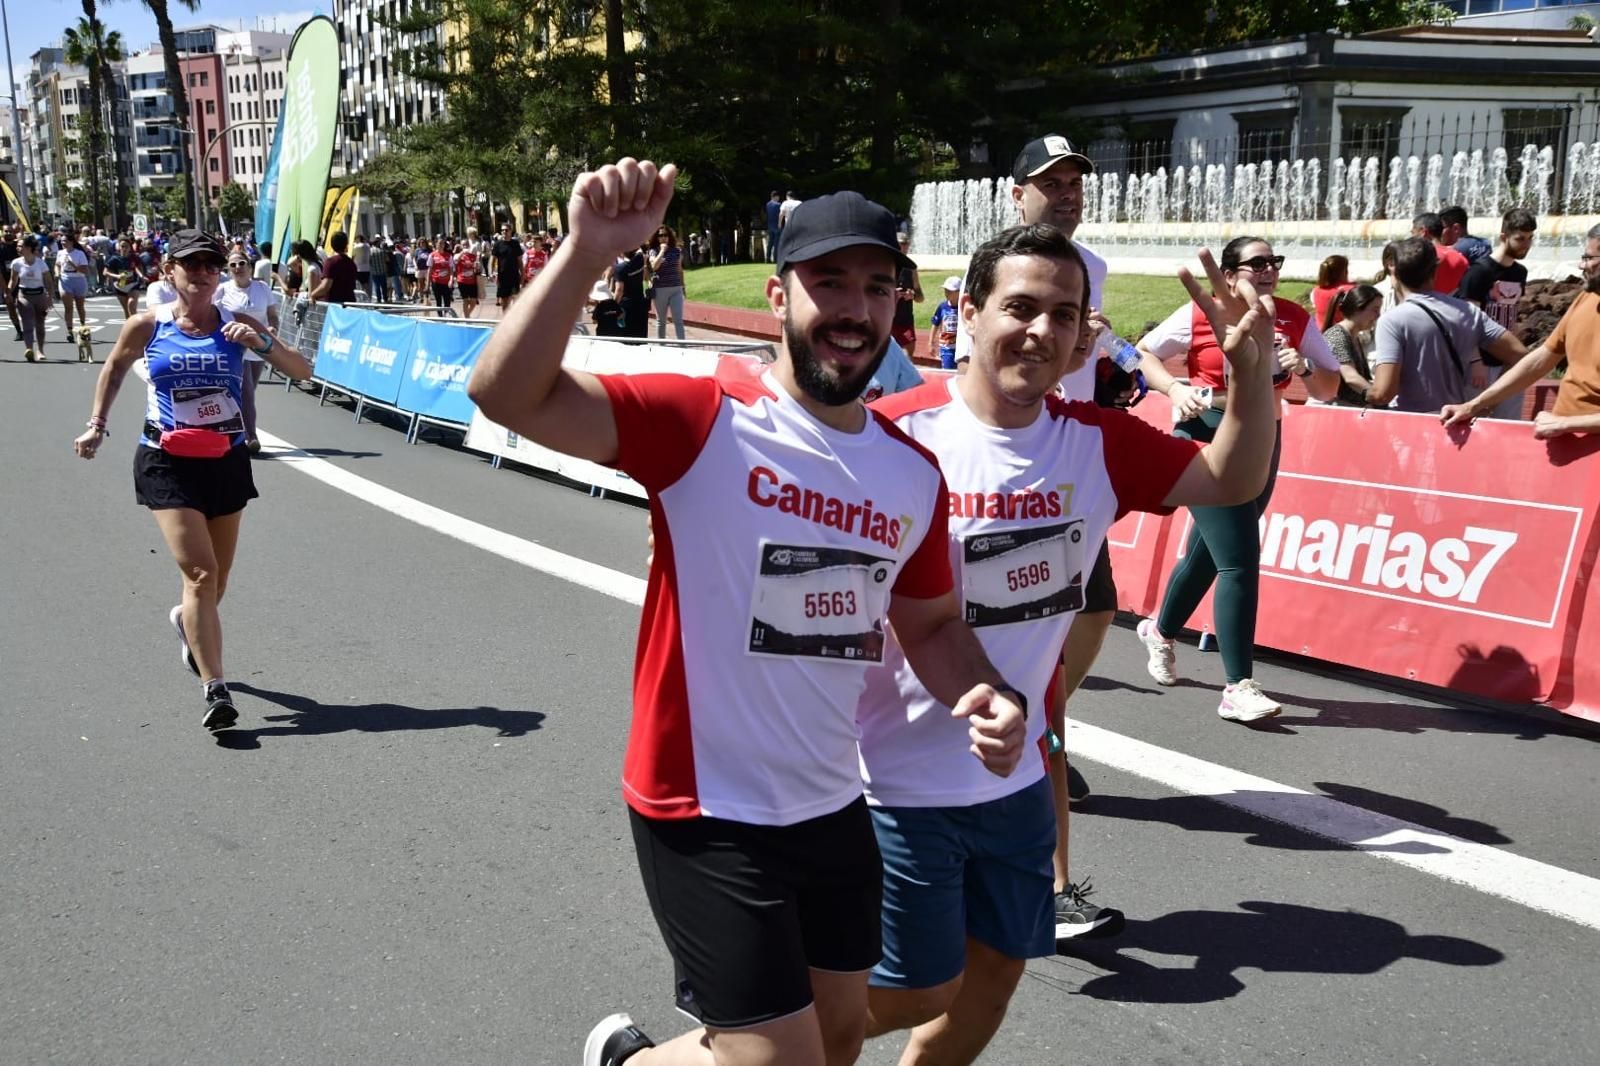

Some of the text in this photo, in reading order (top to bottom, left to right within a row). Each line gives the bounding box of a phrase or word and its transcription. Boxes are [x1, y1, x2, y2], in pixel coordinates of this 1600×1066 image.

[169, 352, 230, 371] SEPE
[198, 404, 221, 418] 5493
[748, 466, 913, 553] Canarias7
[948, 483, 1074, 520] anarias7
[1258, 513, 1518, 603] narias7
[1007, 561, 1050, 592] 5596
[805, 590, 856, 618] 5563
